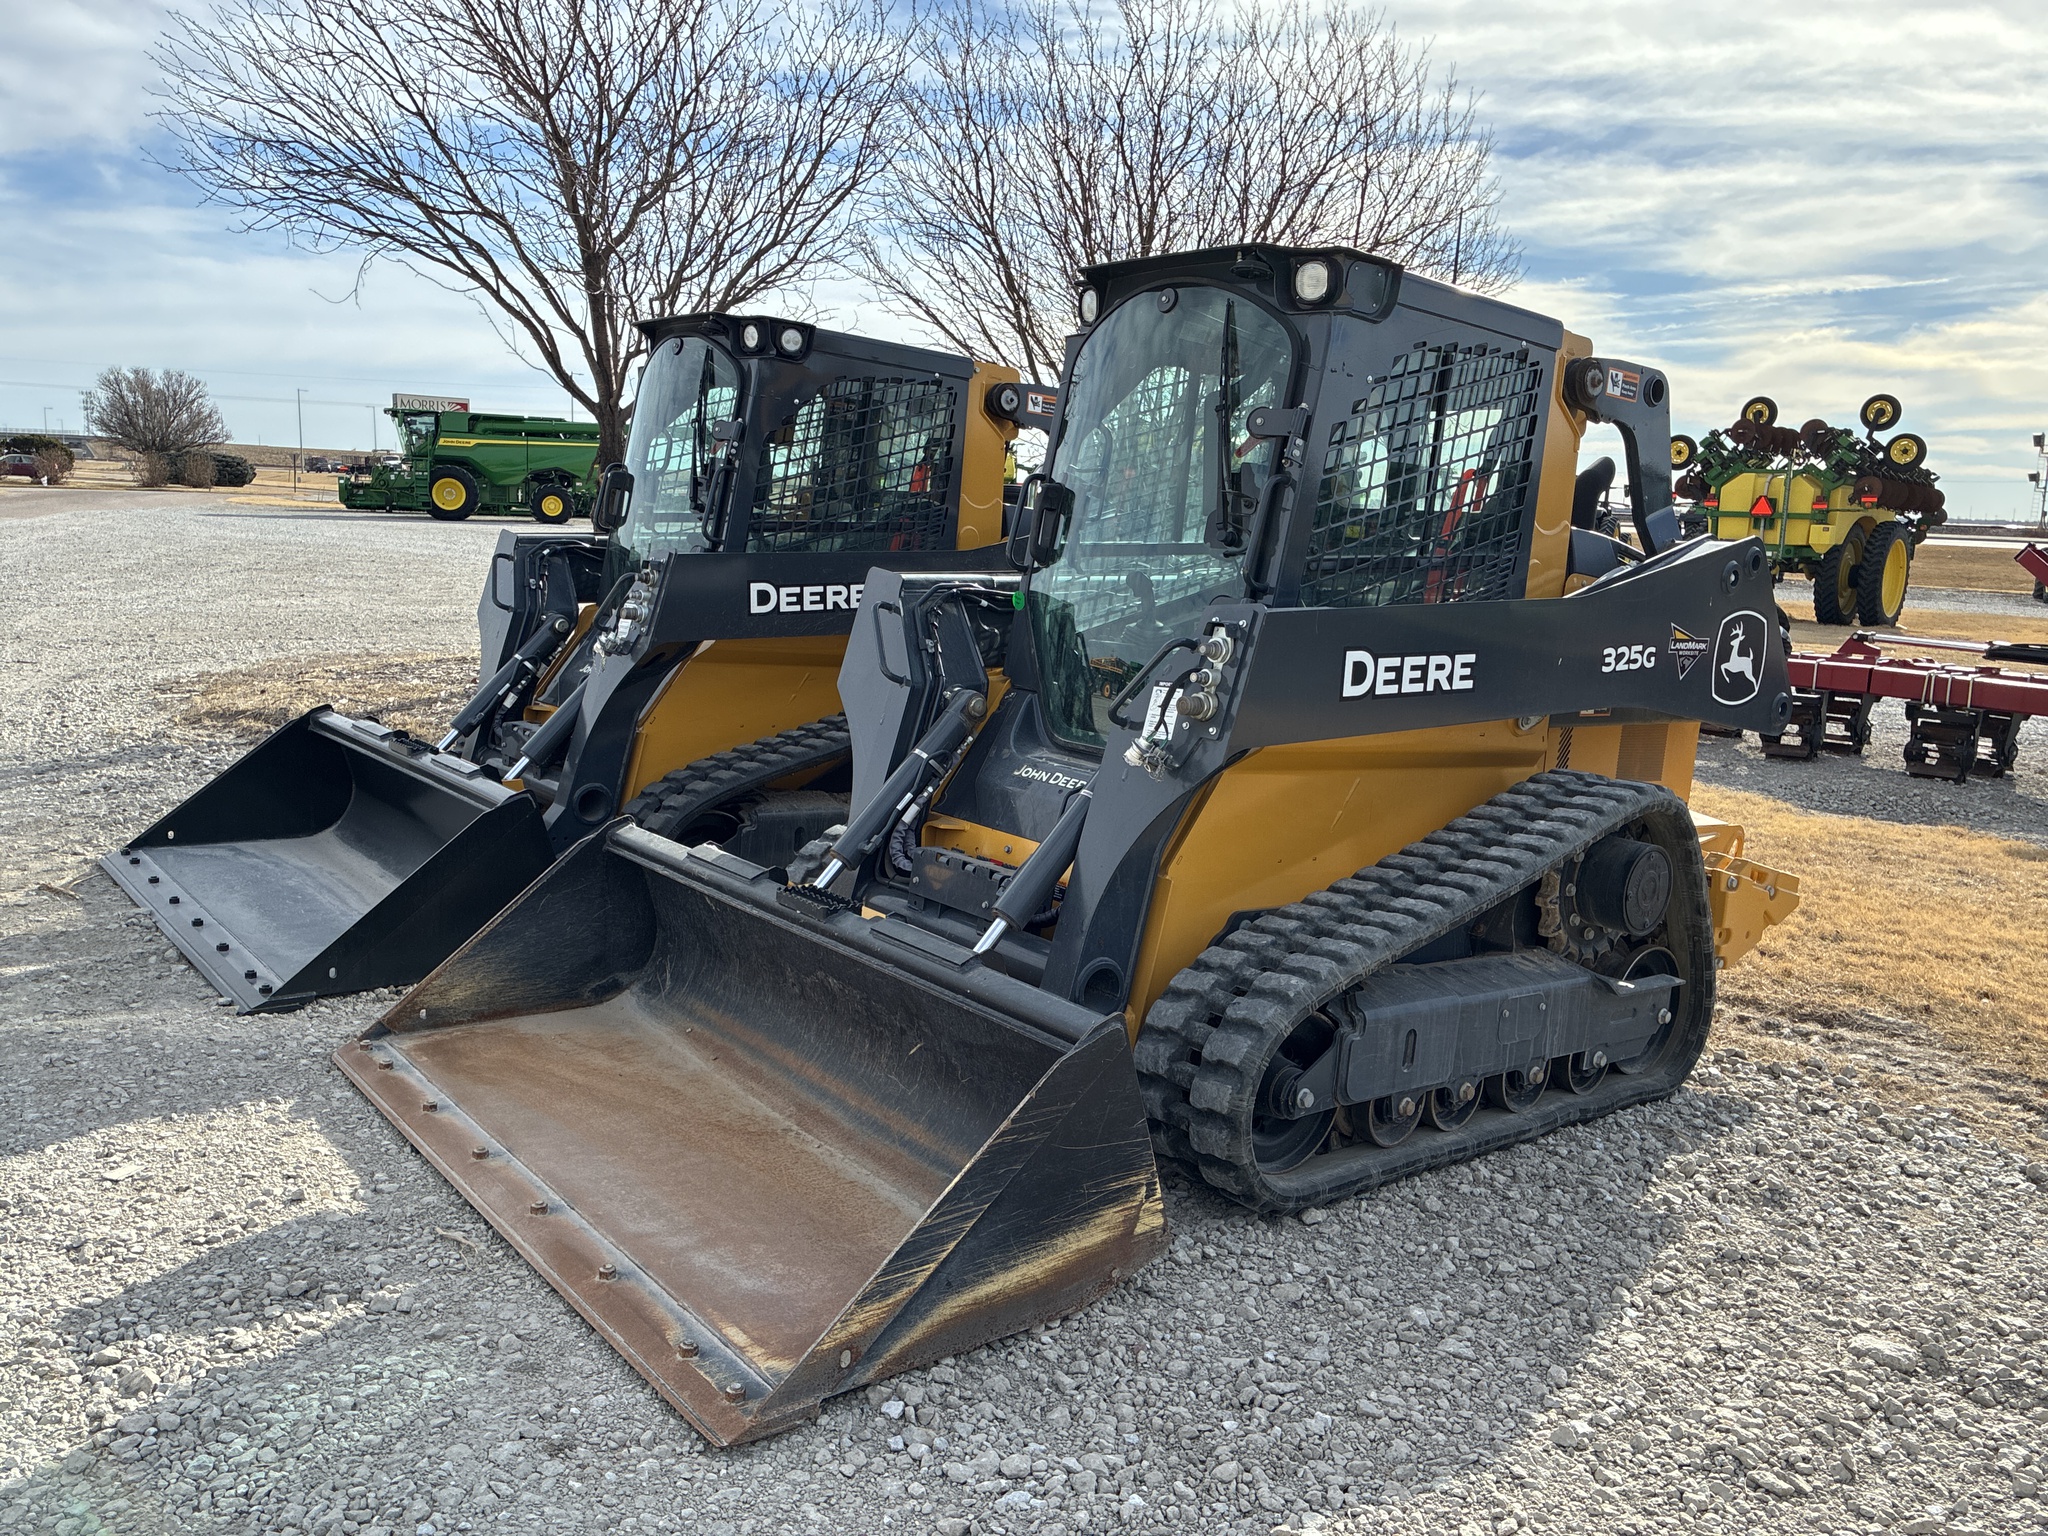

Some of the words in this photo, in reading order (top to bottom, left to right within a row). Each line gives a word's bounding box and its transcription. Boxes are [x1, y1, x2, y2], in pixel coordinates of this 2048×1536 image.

[400, 398, 446, 411] MORRIS
[1601, 645, 1657, 673] 325G
[1342, 650, 1477, 697] DEERE
[1013, 764, 1051, 783] JOHN
[1048, 771, 1087, 789] DEER
